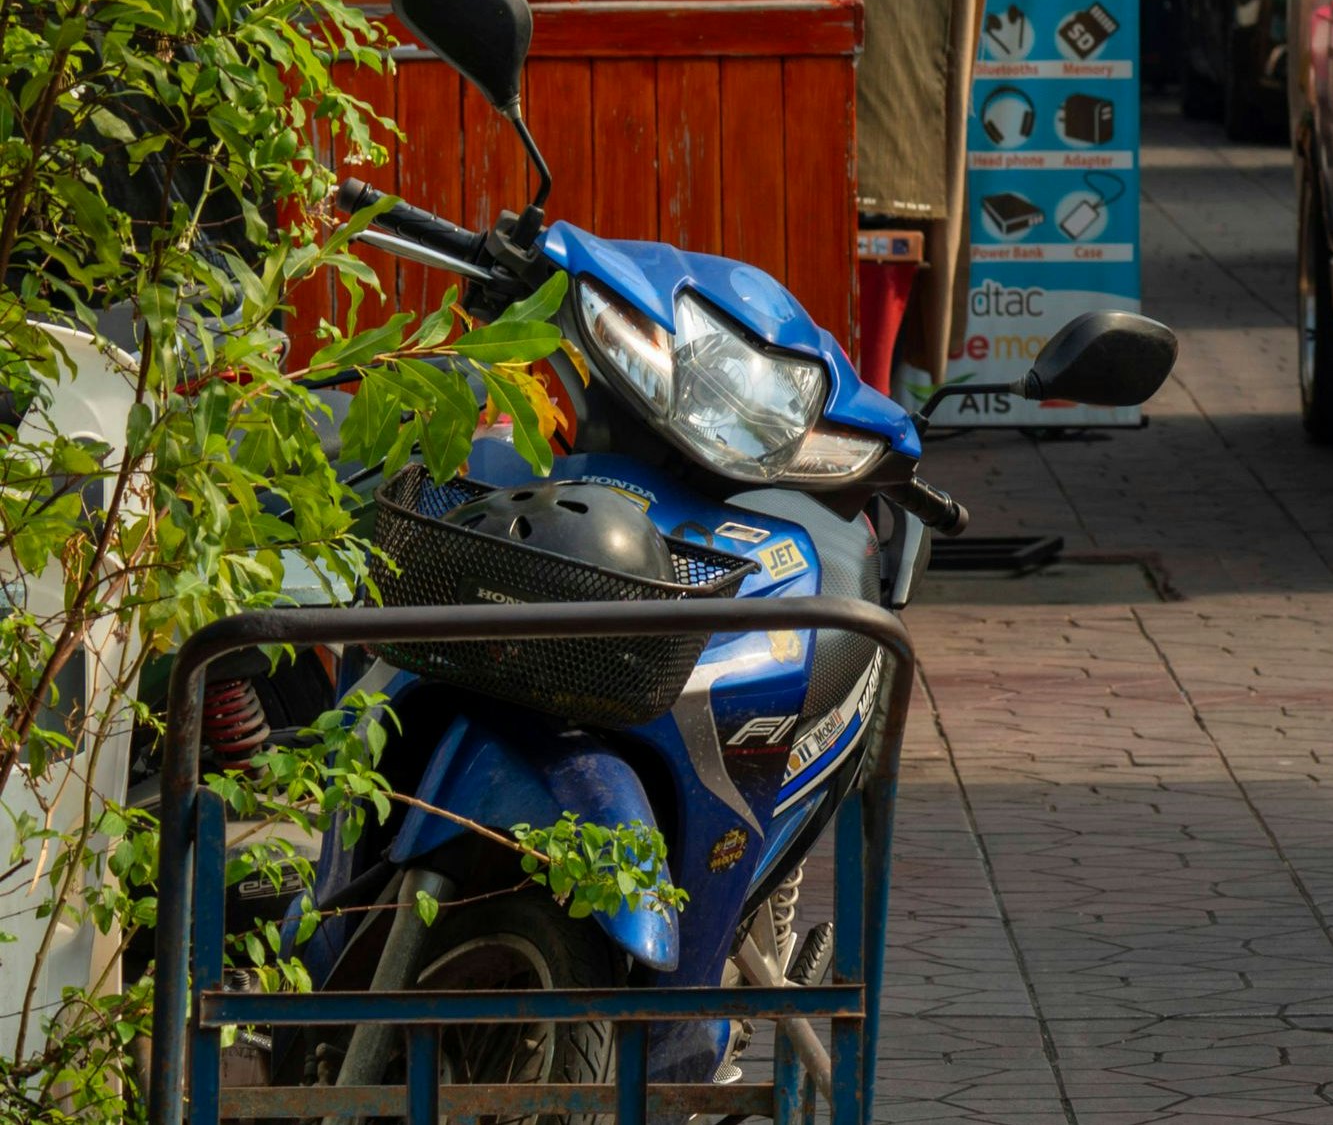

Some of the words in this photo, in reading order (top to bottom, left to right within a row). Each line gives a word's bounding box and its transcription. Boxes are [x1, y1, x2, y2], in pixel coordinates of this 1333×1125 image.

[1067, 23, 1095, 51] SD
[1013, 245, 1044, 259] Bank
[1074, 246, 1103, 259] Case
[971, 286, 1044, 317] dtac
[958, 393, 1011, 415] AIS
[582, 475, 658, 504] HONDA
[770, 544, 794, 571] JET
